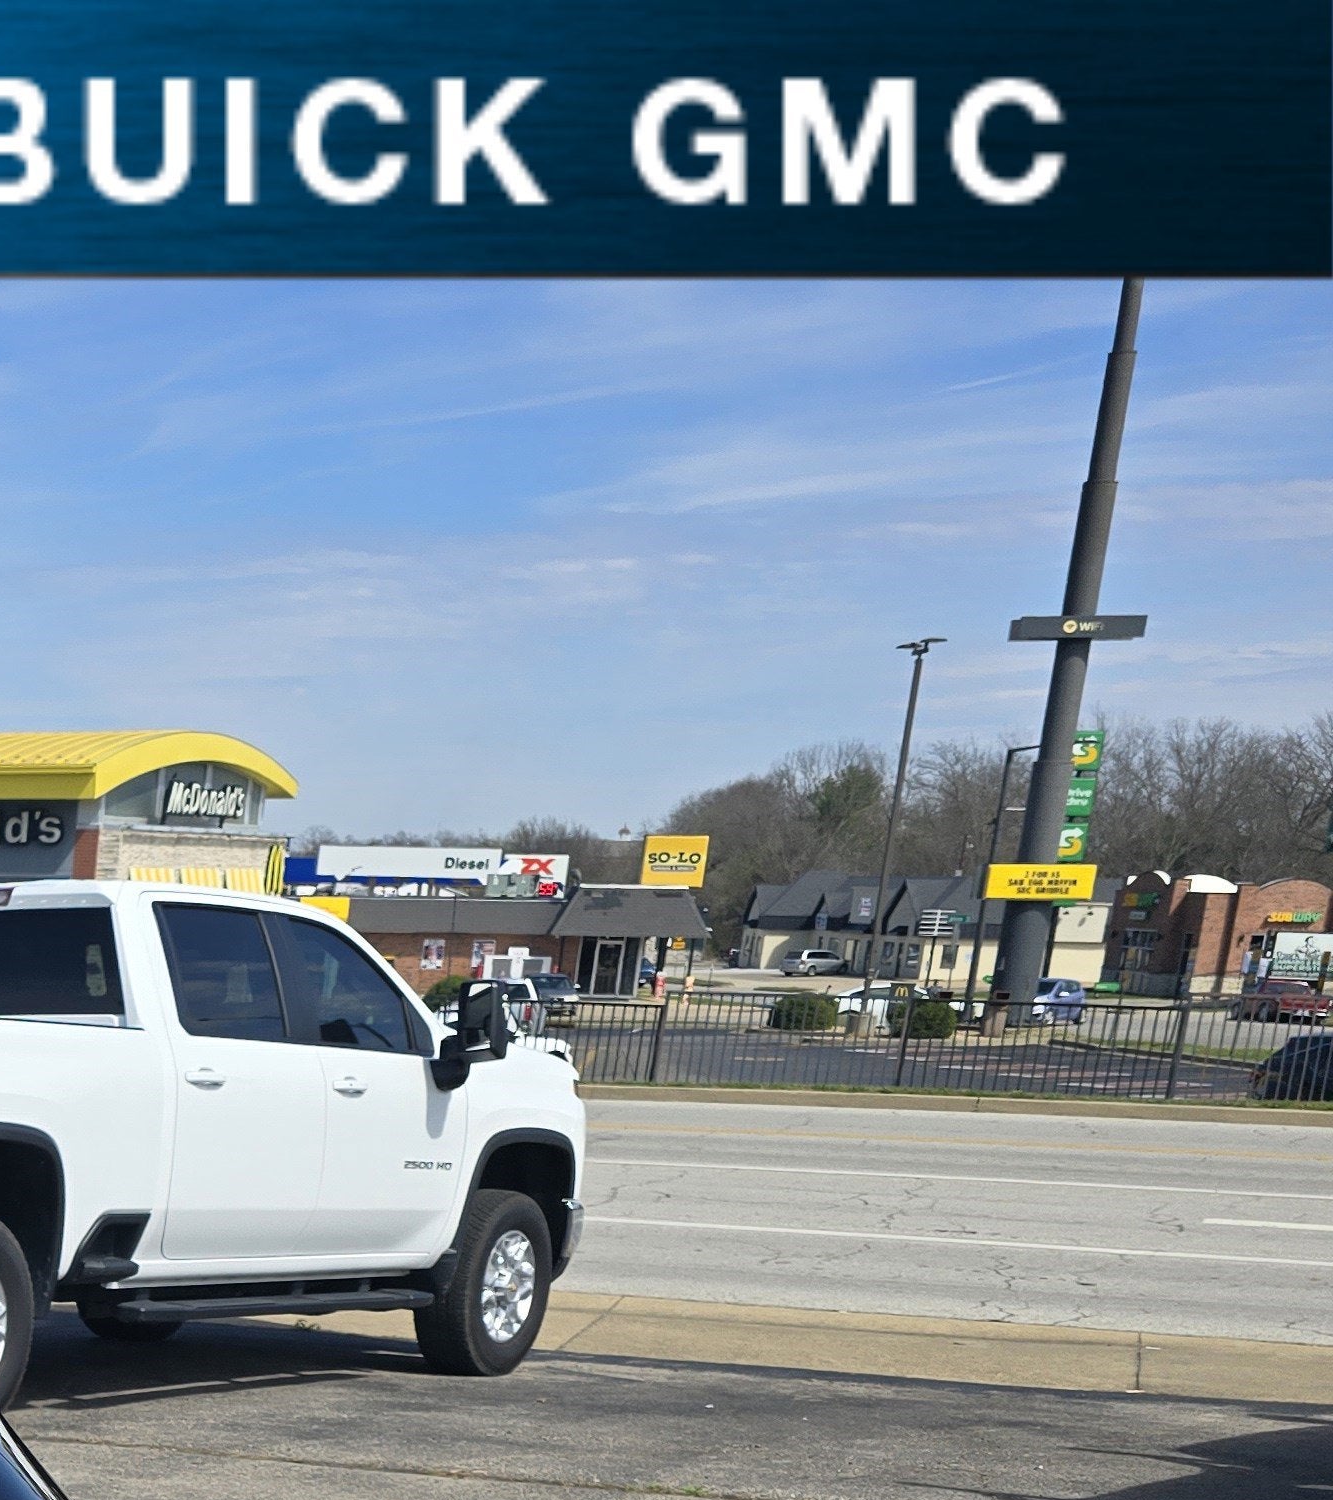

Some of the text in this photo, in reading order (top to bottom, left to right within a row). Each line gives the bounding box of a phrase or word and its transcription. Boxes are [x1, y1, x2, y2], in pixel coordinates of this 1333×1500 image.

[166, 781, 245, 818] McDonald's
[444, 857, 490, 870] Diesel
[648, 851, 702, 864] SO-LO
[1267, 911, 1323, 923] SUBWAY
[403, 1160, 434, 1170] 2500
